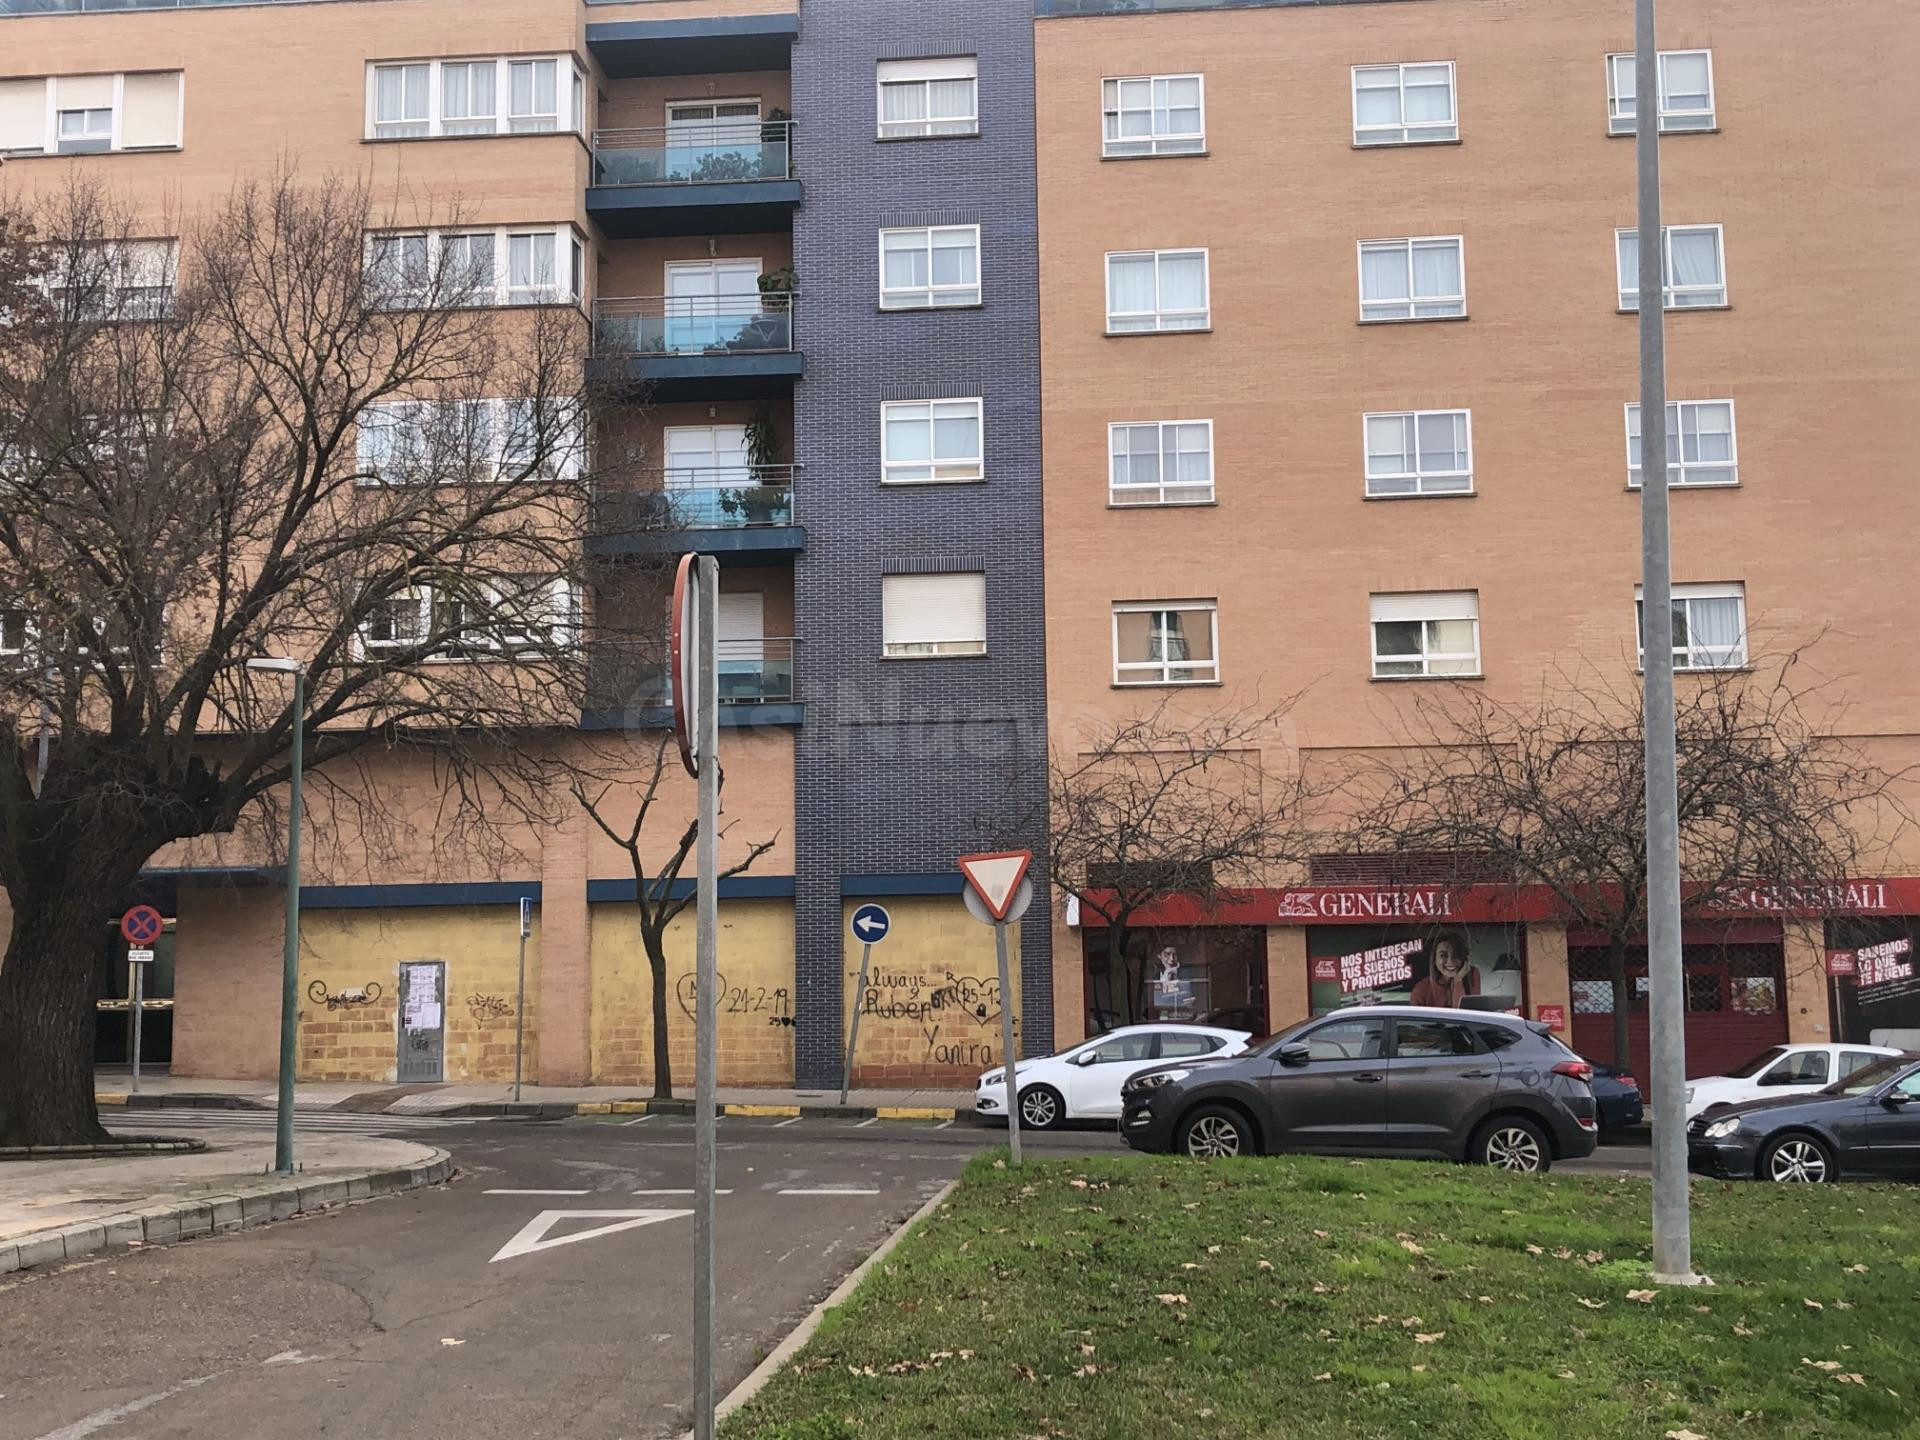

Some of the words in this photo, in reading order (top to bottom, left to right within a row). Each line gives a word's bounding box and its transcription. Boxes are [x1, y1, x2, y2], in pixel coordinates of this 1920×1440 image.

[1319, 891, 1453, 917] GENERALI
[1341, 953, 1362, 969] NOS
[1365, 938, 1422, 962] INTERESAN
[1341, 964, 1362, 980] TUS
[1341, 980, 1350, 993] Y
[1352, 966, 1413, 991] PROYECTOS
[1874, 963, 1912, 983] MUEVE
